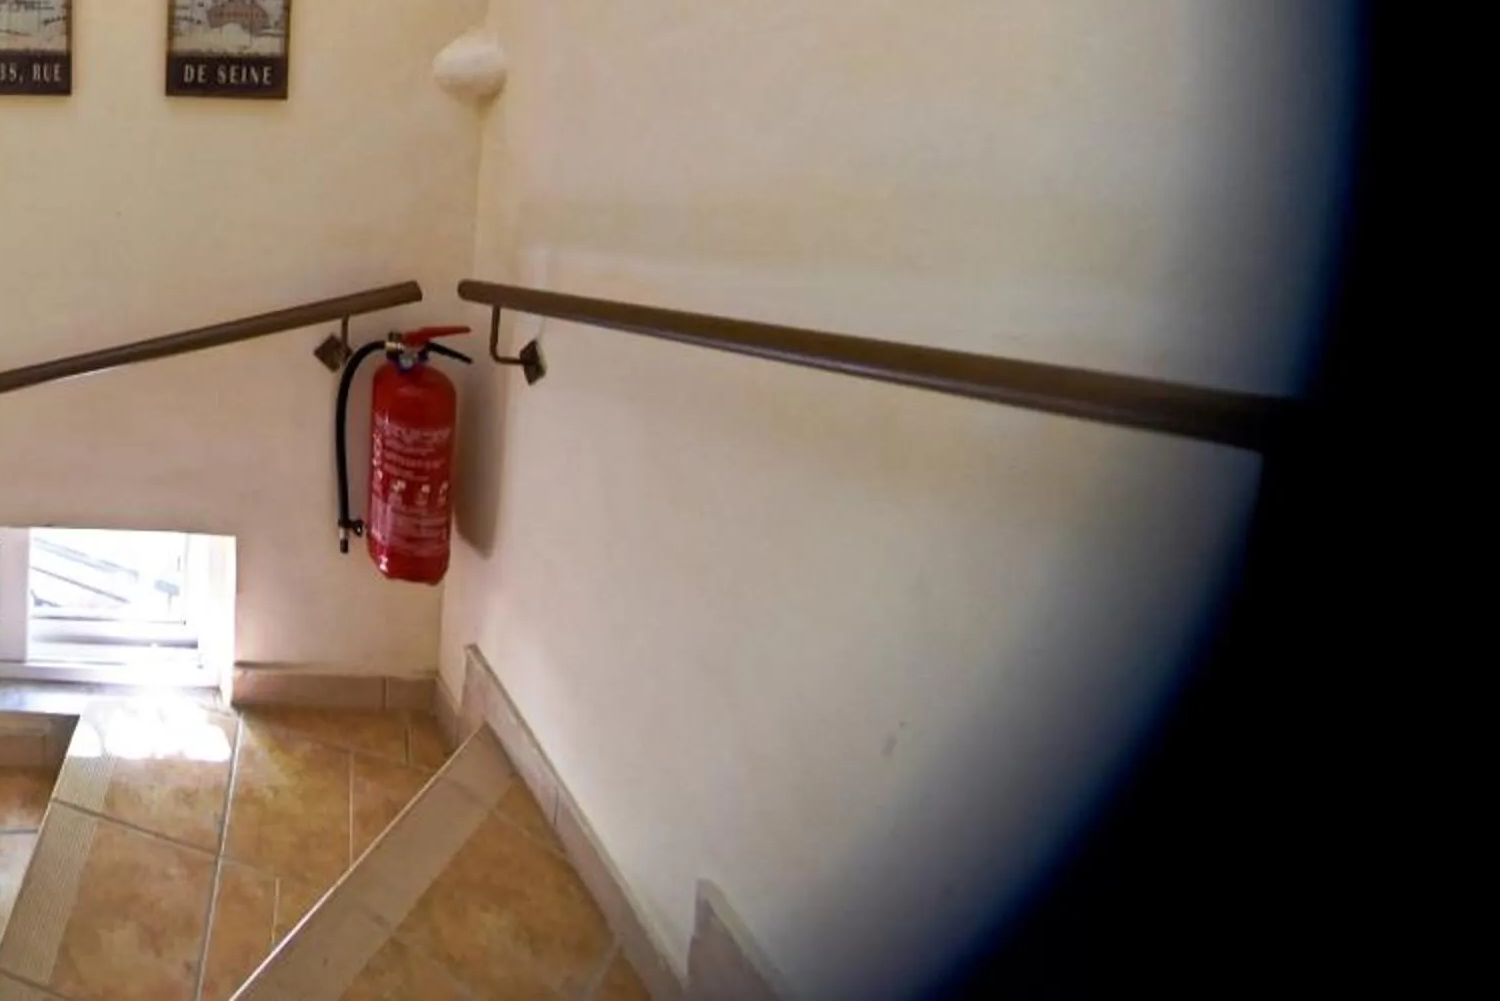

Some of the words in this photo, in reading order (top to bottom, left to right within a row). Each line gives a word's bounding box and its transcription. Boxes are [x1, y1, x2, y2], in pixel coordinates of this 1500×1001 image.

[32, 63, 63, 83] RUE
[183, 64, 206, 84] DE
[216, 65, 273, 85] SEINE
